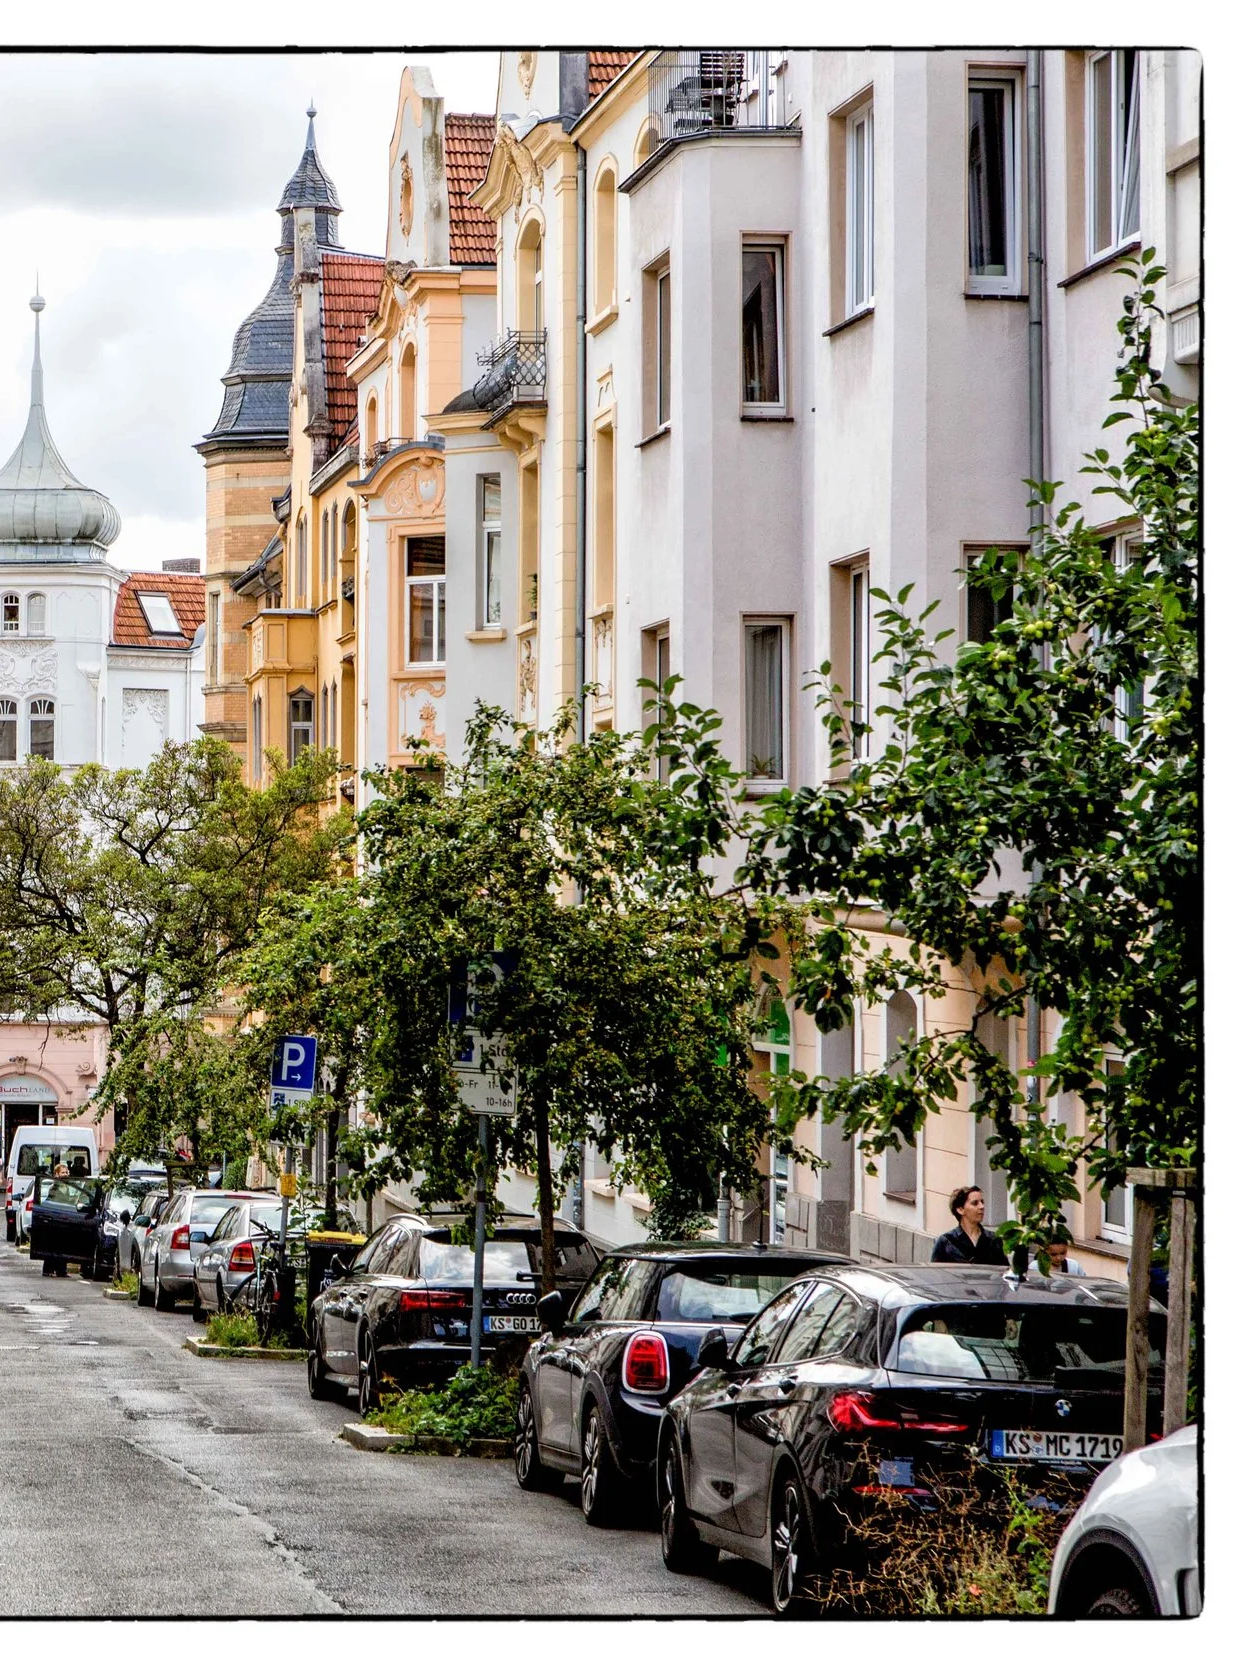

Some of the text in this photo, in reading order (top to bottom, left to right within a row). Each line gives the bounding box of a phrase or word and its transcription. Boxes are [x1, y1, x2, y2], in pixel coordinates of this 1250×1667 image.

[281, 1042, 306, 1081] P
[486, 1098, 513, 1108] 10-16h
[490, 1317, 505, 1330] KS
[1005, 1432, 1030, 1455] KS
[1046, 1435, 1070, 1456] MC
[1075, 1436, 1124, 1459] 1719
